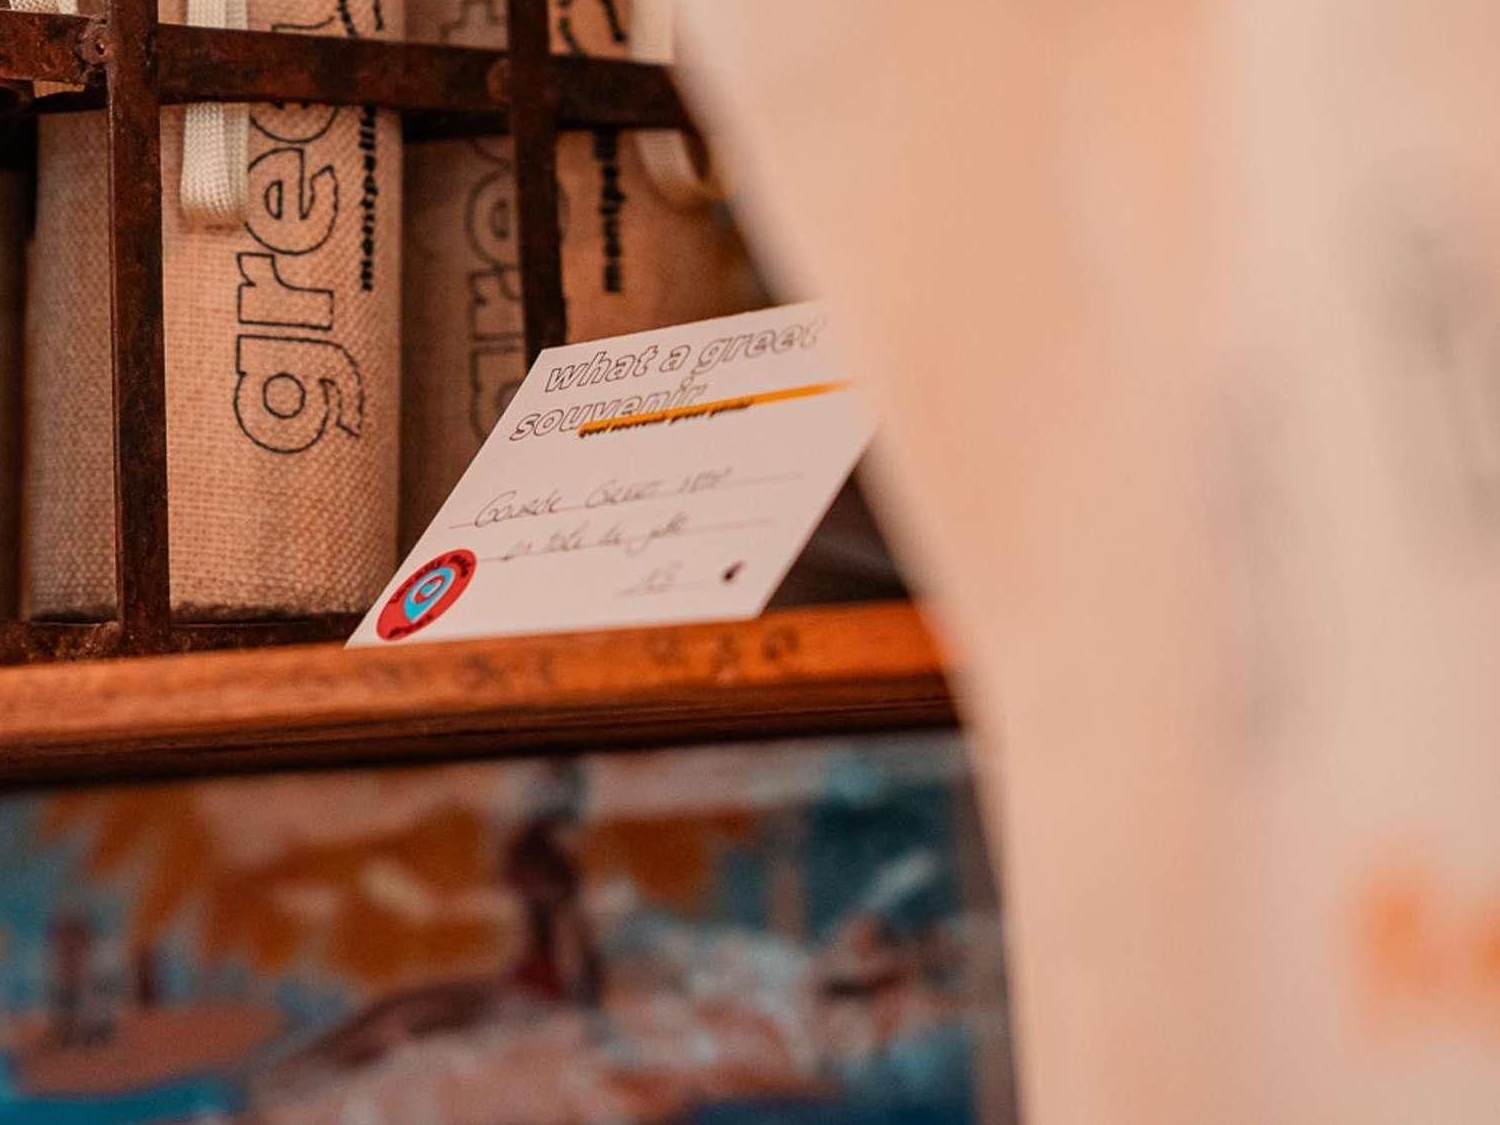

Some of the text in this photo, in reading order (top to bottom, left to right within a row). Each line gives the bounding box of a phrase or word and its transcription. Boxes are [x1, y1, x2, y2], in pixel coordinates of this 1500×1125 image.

[544, 344, 659, 393] what
[659, 344, 691, 373] a
[509, 375, 708, 441] souvenir
